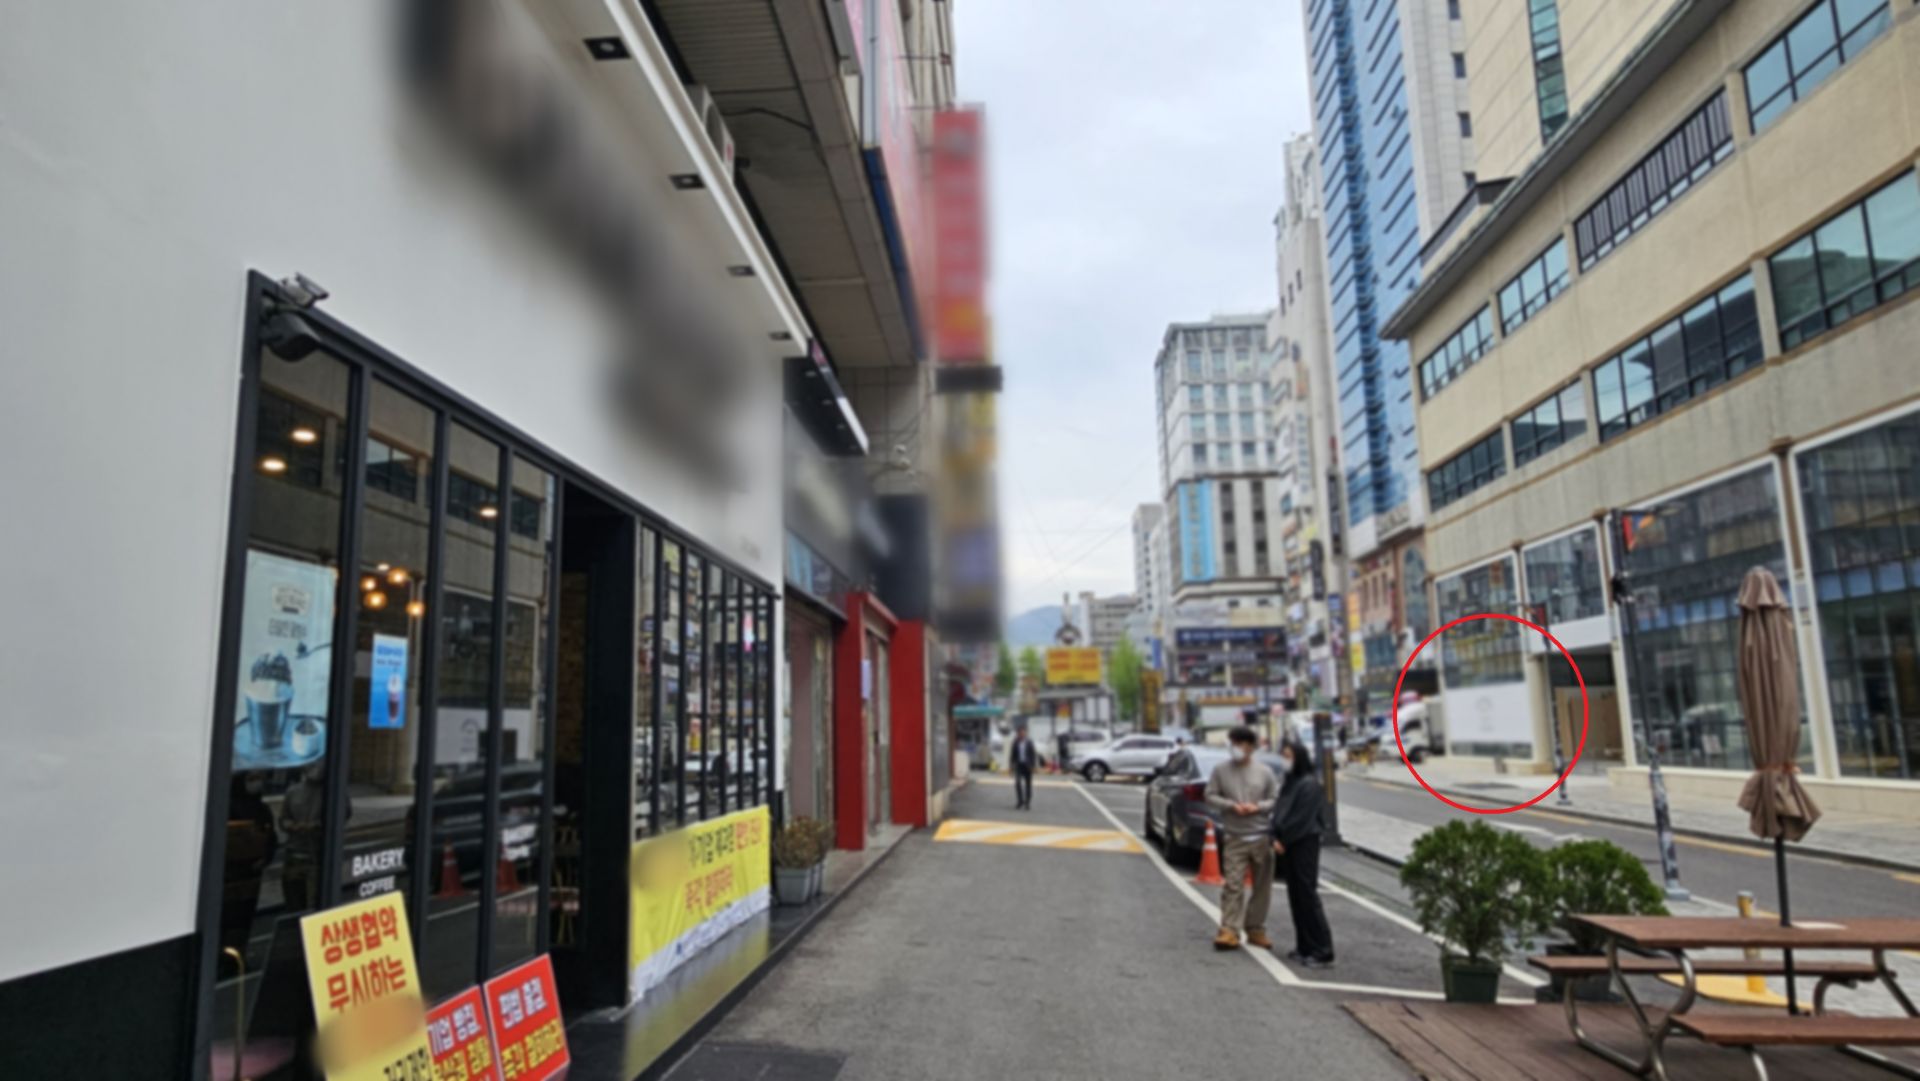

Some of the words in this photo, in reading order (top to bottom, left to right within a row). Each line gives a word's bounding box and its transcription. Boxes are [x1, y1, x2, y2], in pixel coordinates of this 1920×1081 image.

[352, 848, 405, 876] BAKERY
[359, 876, 395, 898] COFFEE
[321, 905, 398, 965] 상생협약
[327, 956, 406, 1013] 무시하는
